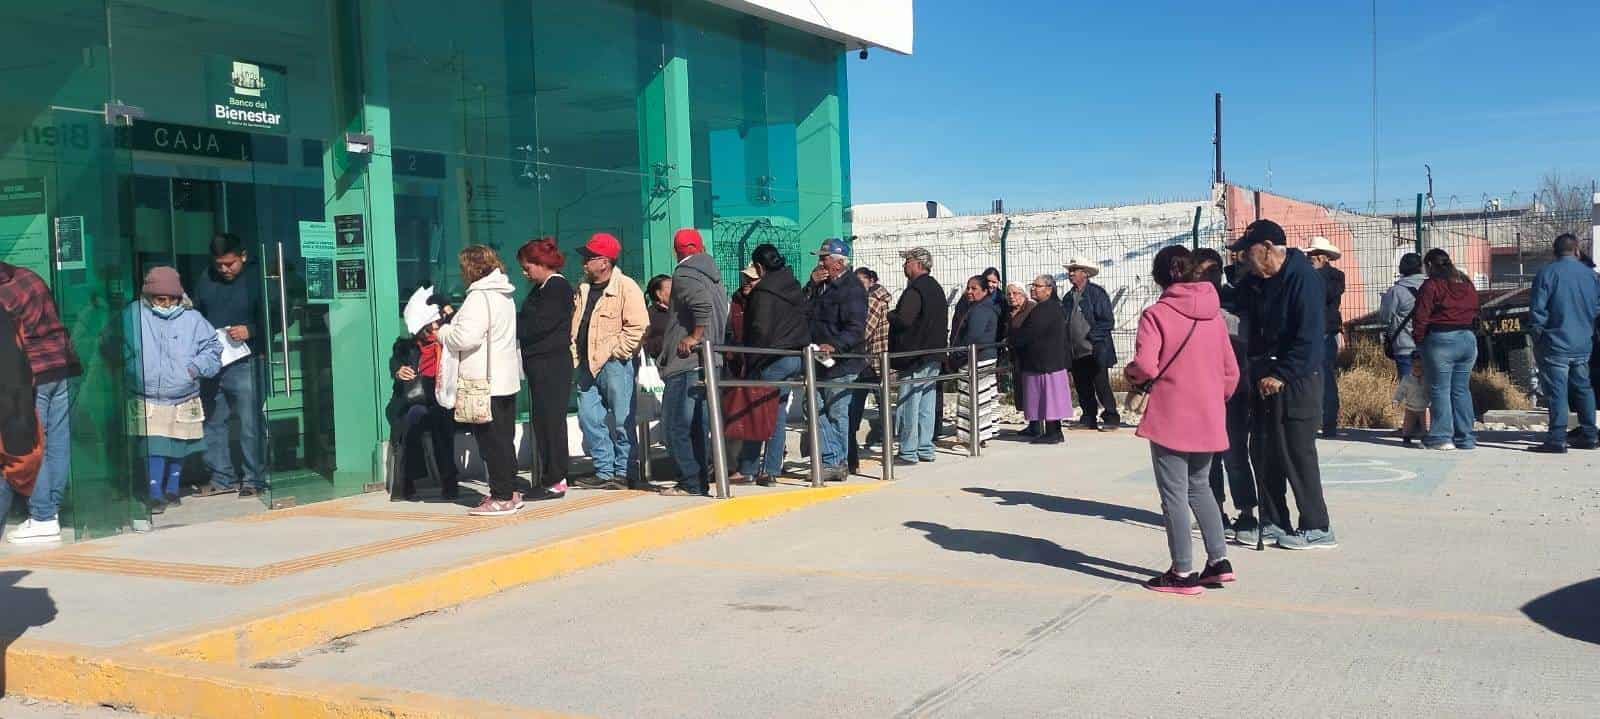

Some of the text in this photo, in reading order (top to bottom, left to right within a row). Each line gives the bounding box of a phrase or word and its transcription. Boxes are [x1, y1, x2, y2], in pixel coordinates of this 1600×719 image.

[229, 97, 268, 109] Banco del
[215, 104, 281, 124] Bienestar
[154, 127, 220, 153] CAJA
[407, 154, 417, 171] 2
